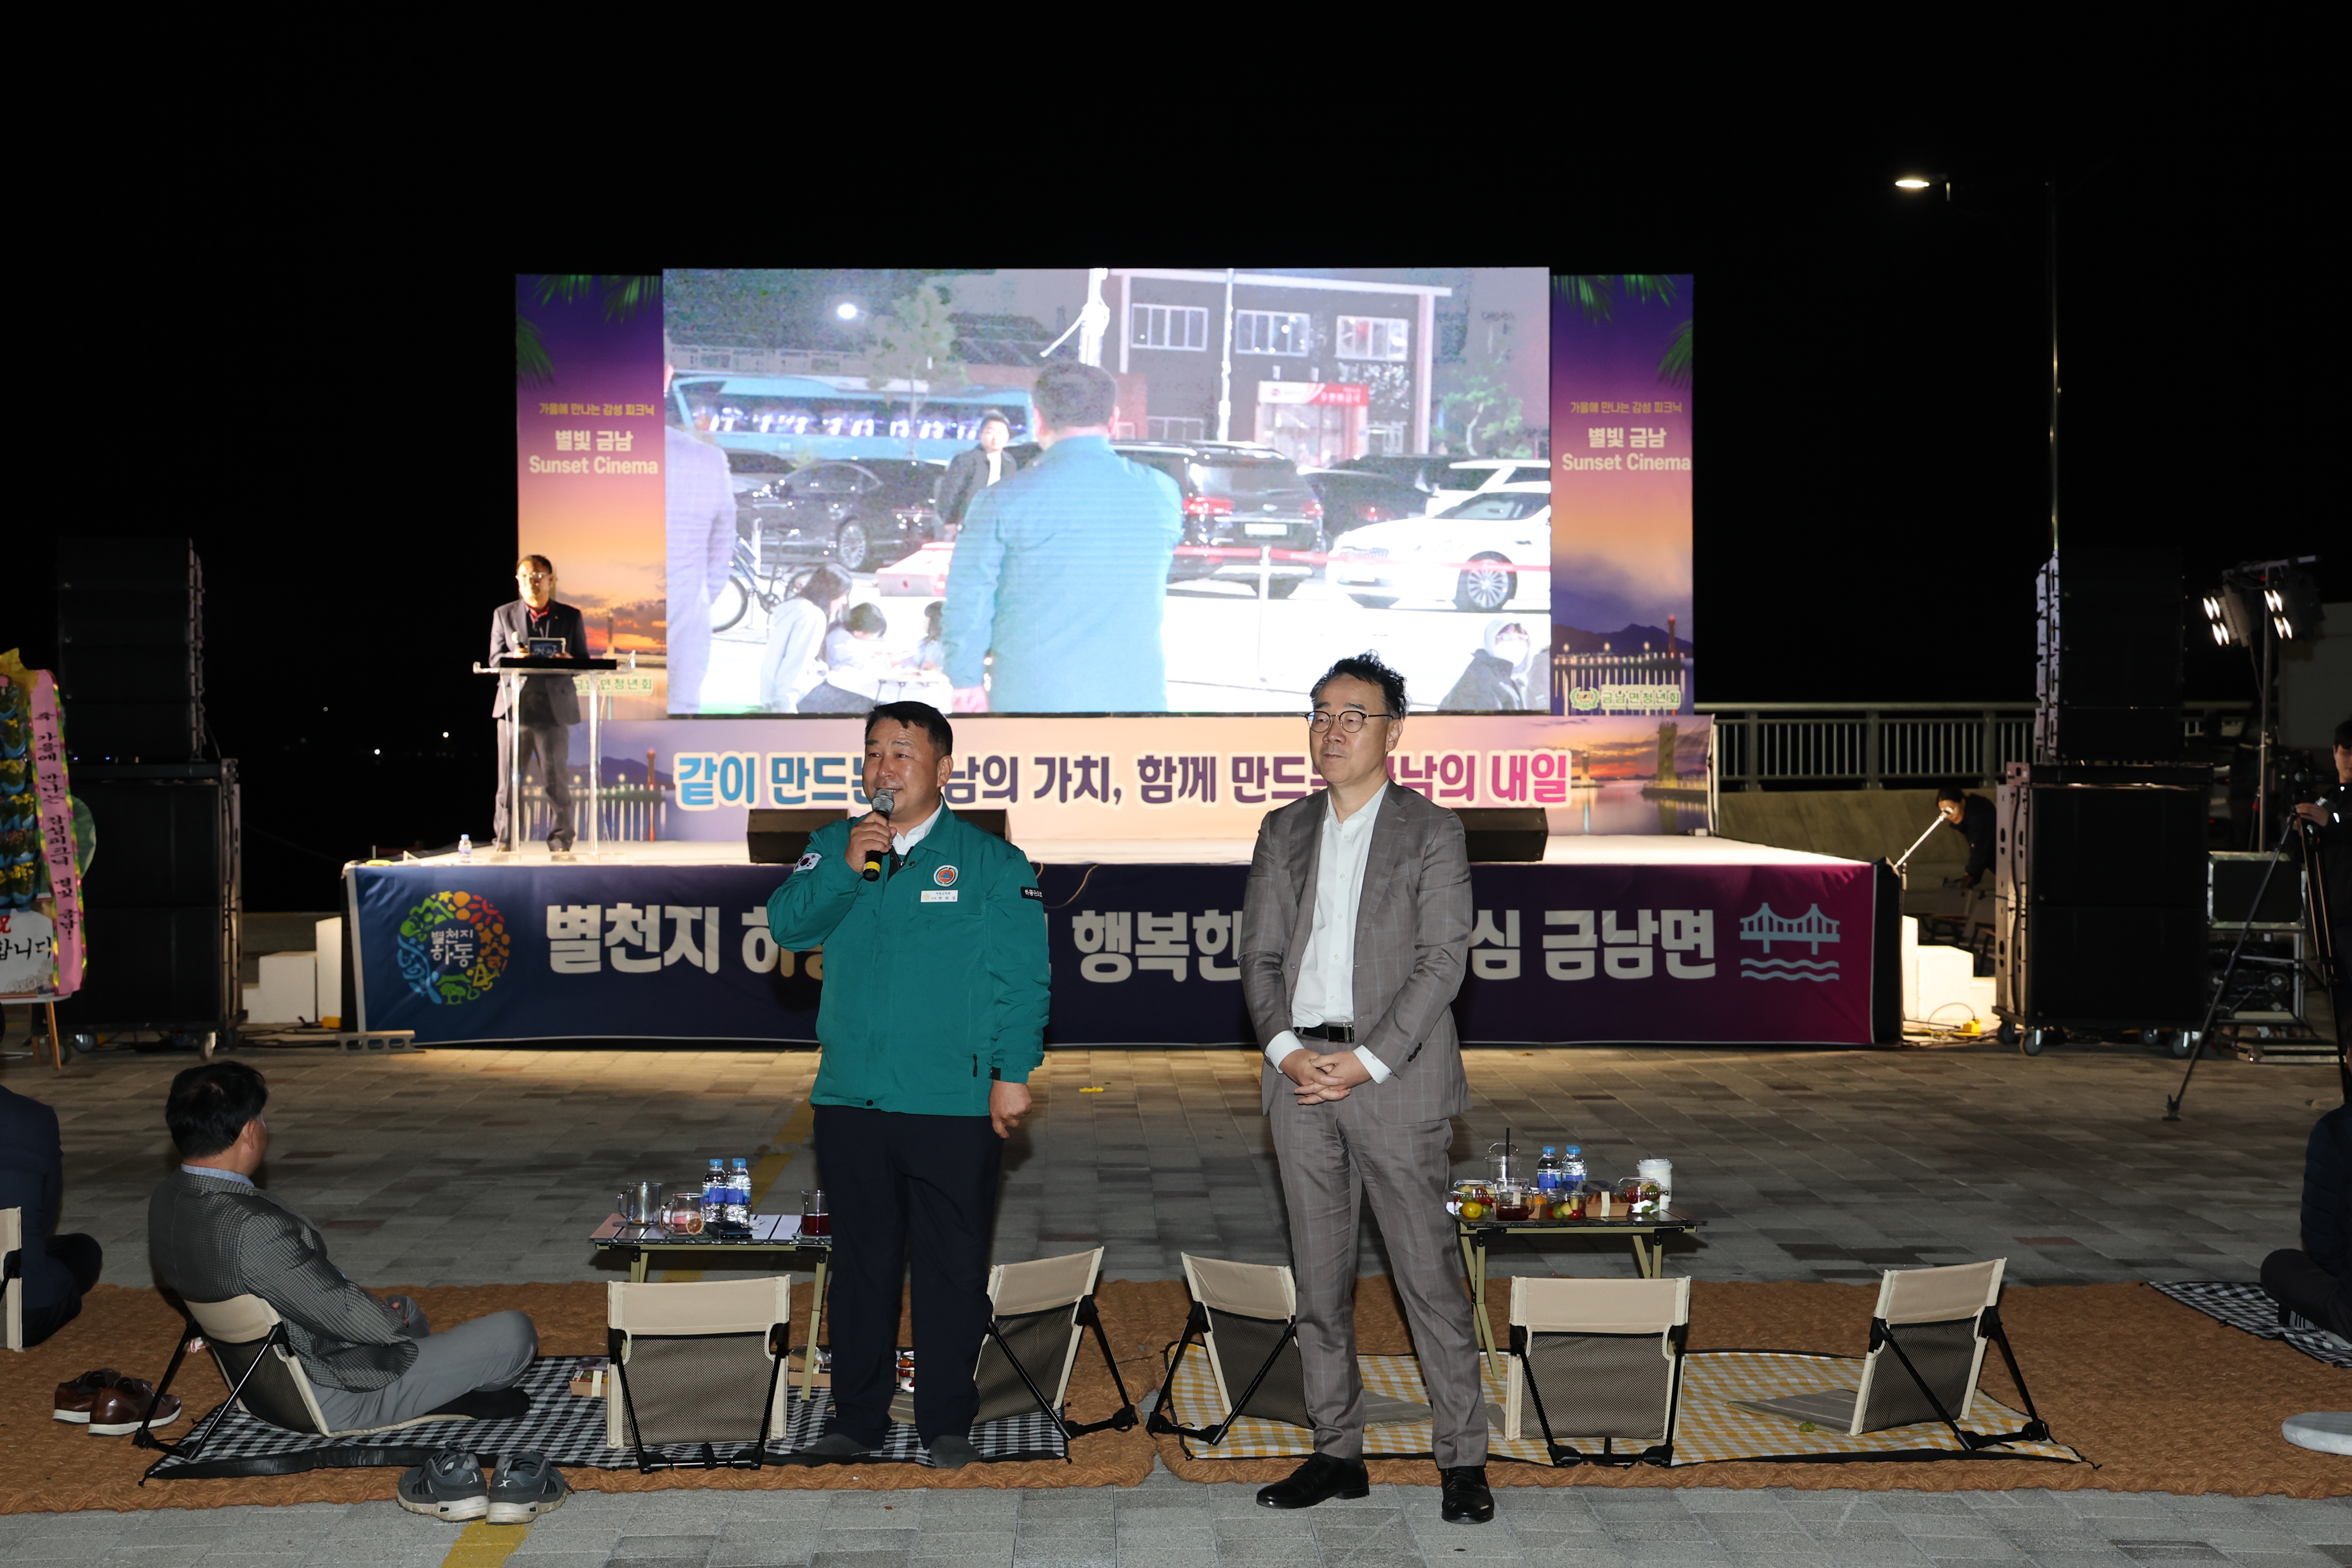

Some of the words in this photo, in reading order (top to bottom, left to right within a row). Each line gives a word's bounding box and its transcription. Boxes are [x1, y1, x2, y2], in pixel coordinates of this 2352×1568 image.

[539, 403, 568, 415] 가을에
[571, 403, 600, 416] 만나는
[603, 404, 622, 416] 감성
[626, 404, 654, 416] 피크닉
[1570, 402, 1599, 414] 가을에
[1601, 401, 1629, 414] 만나는
[1633, 401, 1651, 414] 감성
[1654, 402, 1682, 414] 피크닉
[555, 430, 591, 451] 별빛
[596, 430, 633, 451] 금남
[1588, 427, 1624, 448] 별빛
[1629, 427, 1667, 448] 금남
[529, 455, 589, 474] Sunset
[594, 455, 659, 474] Cinema
[1562, 453, 1622, 470] Sunset
[1627, 453, 1691, 470] Cinema
[1603, 692, 1679, 703] 금남면청년회
[679, 756, 755, 805] 같이
[944, 755, 1018, 804] 남의
[1034, 755, 1121, 804] 가치,
[1137, 755, 1216, 803] 함께
[1387, 754, 1475, 802] 남의
[1492, 754, 1566, 803] 내일
[431, 928, 474, 945] 별천지
[547, 903, 720, 975] 별천지
[742, 906, 823, 980] 하
[1072, 909, 1243, 983] 행복한
[1468, 909, 1521, 980] 심
[1542, 909, 1716, 981] 금남면
[430, 943, 474, 968] 하동
